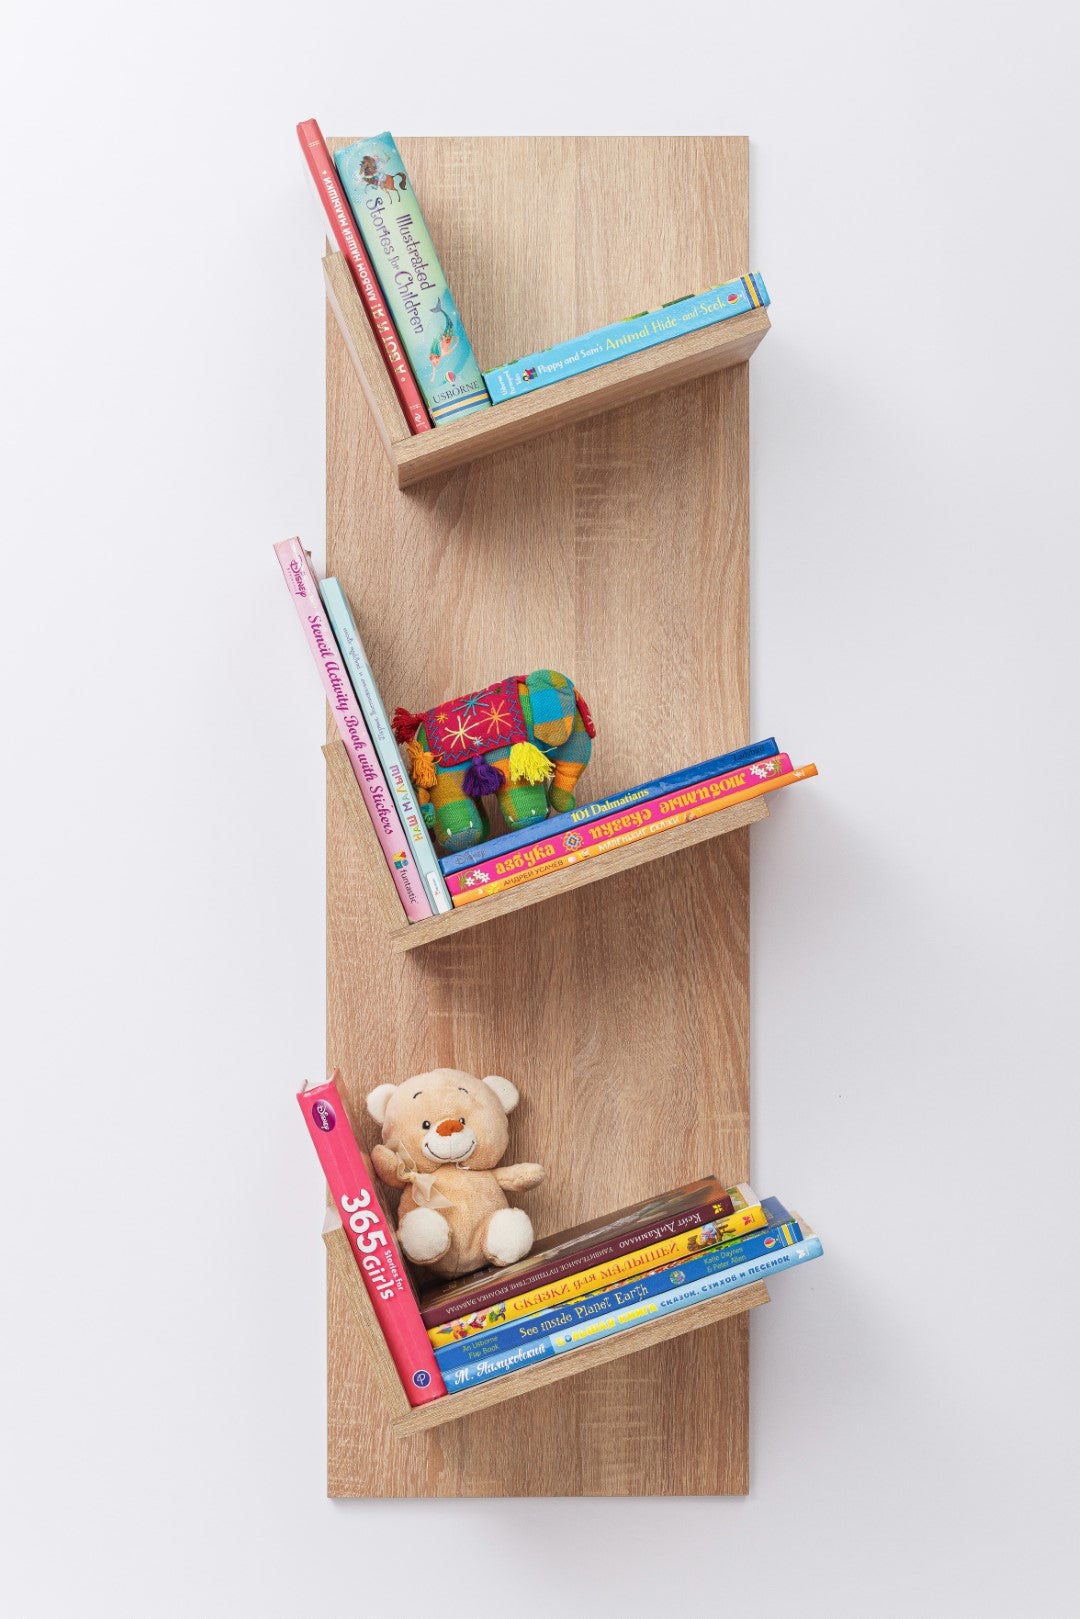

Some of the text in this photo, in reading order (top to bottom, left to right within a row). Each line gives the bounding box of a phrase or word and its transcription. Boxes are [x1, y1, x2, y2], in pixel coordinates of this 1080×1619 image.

[320, 175, 379, 302] АЛЬБОМ НАШЕЙ МАЛЫШКИ
[394, 212, 436, 292] Illustrated
[364, 195, 430, 335] Stories for Children
[368, 302, 406, 376] А ВОТ И Я!
[536, 357, 564, 376] Poppy
[561, 350, 580, 364] and
[579, 342, 604, 358] Sam's
[602, 324, 650, 351] Animal
[431, 380, 481, 405] USBORNE
[306, 612, 398, 836] Stencil Activity Book with Stickers
[570, 786, 650, 823] 101 Dalmatians
[587, 771, 749, 843] любимые сказки
[648, 815, 680, 833] СКАЗКИ
[492, 840, 557, 878] азбука
[501, 868, 535, 887] АНДРЕЙ
[398, 868, 418, 904] funtastic
[338, 1185, 388, 1256] 365
[675, 1211, 702, 1229] Кейт
[360, 1250, 399, 1303] Girls
[383, 1249, 405, 1291] Stories for
[445, 1245, 614, 1315] УДИВИТЕЛЬНОЕ ПУТЕШЕСТВИЕ КРОЛИКА ЭДВАРДА
[511, 1282, 570, 1312] СКАЗКИ
[598, 1241, 680, 1280] МАЛЫШЕЙ
[659, 1253, 791, 1308] СКАЗОК, СТИХОВ И ПЕСЕНОК
[702, 1253, 720, 1265] Katie
[711, 1259, 729, 1270] Peter
[518, 1282, 650, 1339] See inside Planet Earth
[554, 1301, 658, 1348] БОЛЬШАЯ КНИГА
[451, 1340, 548, 1385] М. Пляцковский
[471, 1334, 498, 1349] Usborne
[481, 1342, 499, 1354] Book
